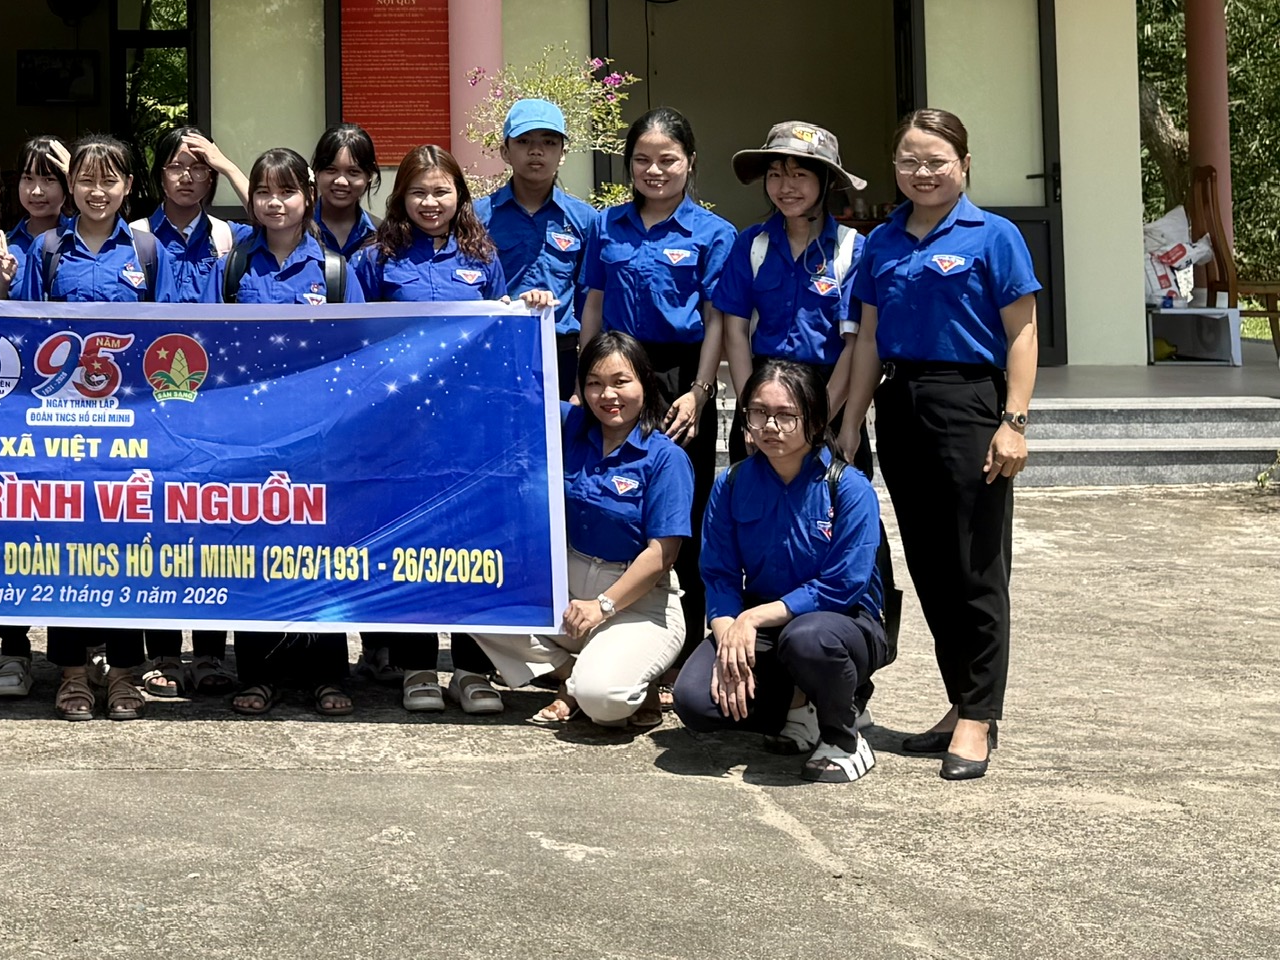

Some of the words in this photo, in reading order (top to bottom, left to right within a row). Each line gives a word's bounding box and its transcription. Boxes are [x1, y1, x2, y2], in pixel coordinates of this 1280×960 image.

[96, 336, 121, 348] NĂM
[46, 397, 67, 408] NGÀY
[70, 398, 97, 408] THÀNH
[99, 398, 115, 410] LẬP
[30, 411, 53, 422] ĐOÀN
[55, 412, 76, 422] TNCS
[108, 413, 130, 423] MINH
[0, 434, 35, 457] XÃ
[44, 434, 102, 461] VIỆT
[109, 438, 149, 458] AN
[95, 469, 154, 523] VỀ
[165, 470, 326, 524] NGUỒN
[4, 535, 60, 576] ĐOÀN
[66, 542, 118, 577] TNCS
[126, 532, 155, 578] HỒ
[160, 536, 194, 578] CHÍ
[200, 544, 254, 578] MINH
[263, 546, 369, 583] (26/3/1931
[392, 546, 504, 588] 26/3/2026)
[31, 585, 52, 602] 22
[59, 583, 113, 607] tháng
[120, 587, 130, 603] 3
[137, 585, 178, 604] năm
[183, 587, 228, 605] 2026
